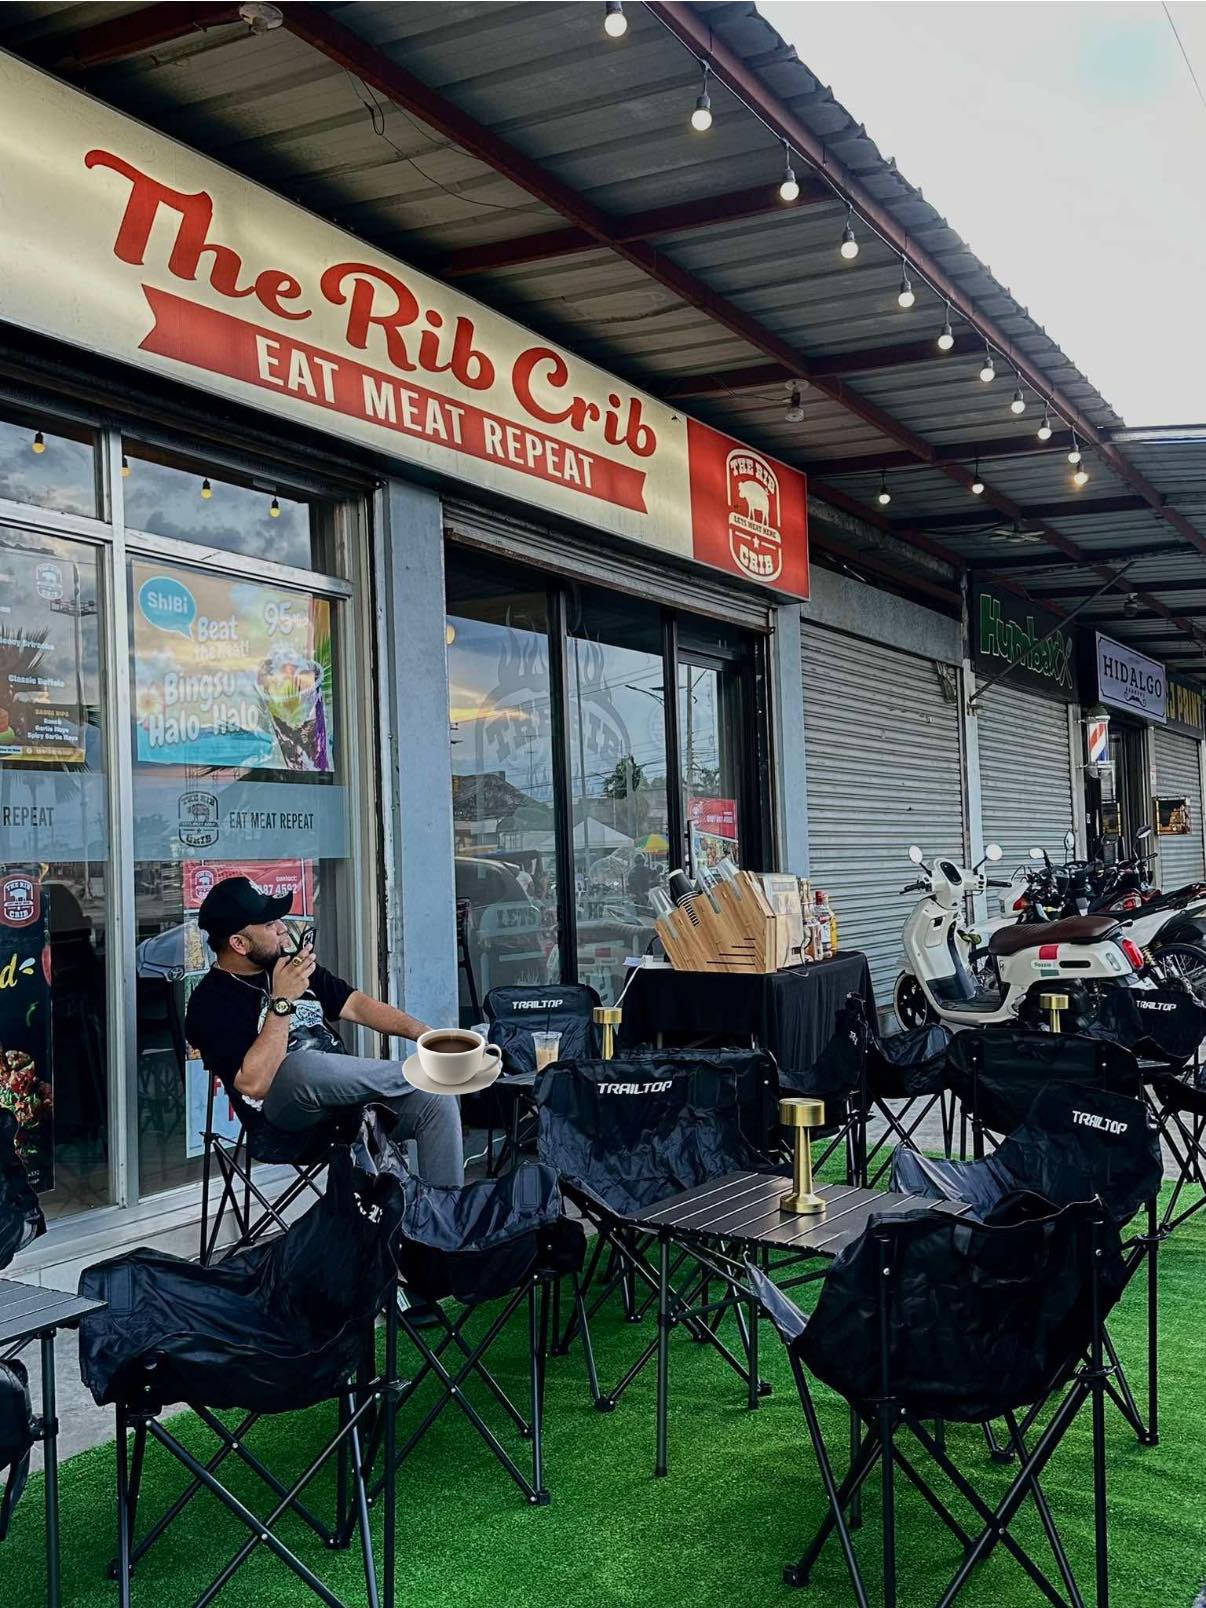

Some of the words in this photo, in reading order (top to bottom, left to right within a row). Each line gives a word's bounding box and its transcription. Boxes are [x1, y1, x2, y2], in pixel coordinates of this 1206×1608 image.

[85, 148, 312, 320] The
[320, 262, 495, 390] Rib
[512, 347, 656, 457] Crib
[256, 334, 340, 405] EAT
[362, 373, 465, 443] MEAT
[484, 417, 594, 489] REPEAT
[730, 457, 754, 477] THE
[755, 462, 776, 494] RIB
[739, 543, 774, 574] CRIB
[197, 616, 238, 642] Beat
[1102, 654, 1162, 698] HIDALGO
[163, 672, 236, 712] Bingsu
[3, 806, 54, 826] REPEAT
[229, 812, 247, 829] EAT
[250, 812, 277, 829] MEAT
[280, 813, 313, 829] REPEAT
[511, 999, 563, 1009] TRAILTOP
[1136, 999, 1177, 1011] TRAILTOP
[597, 1080, 673, 1095] TRAILTOP
[1072, 1110, 1128, 1136] TRAILTOP
